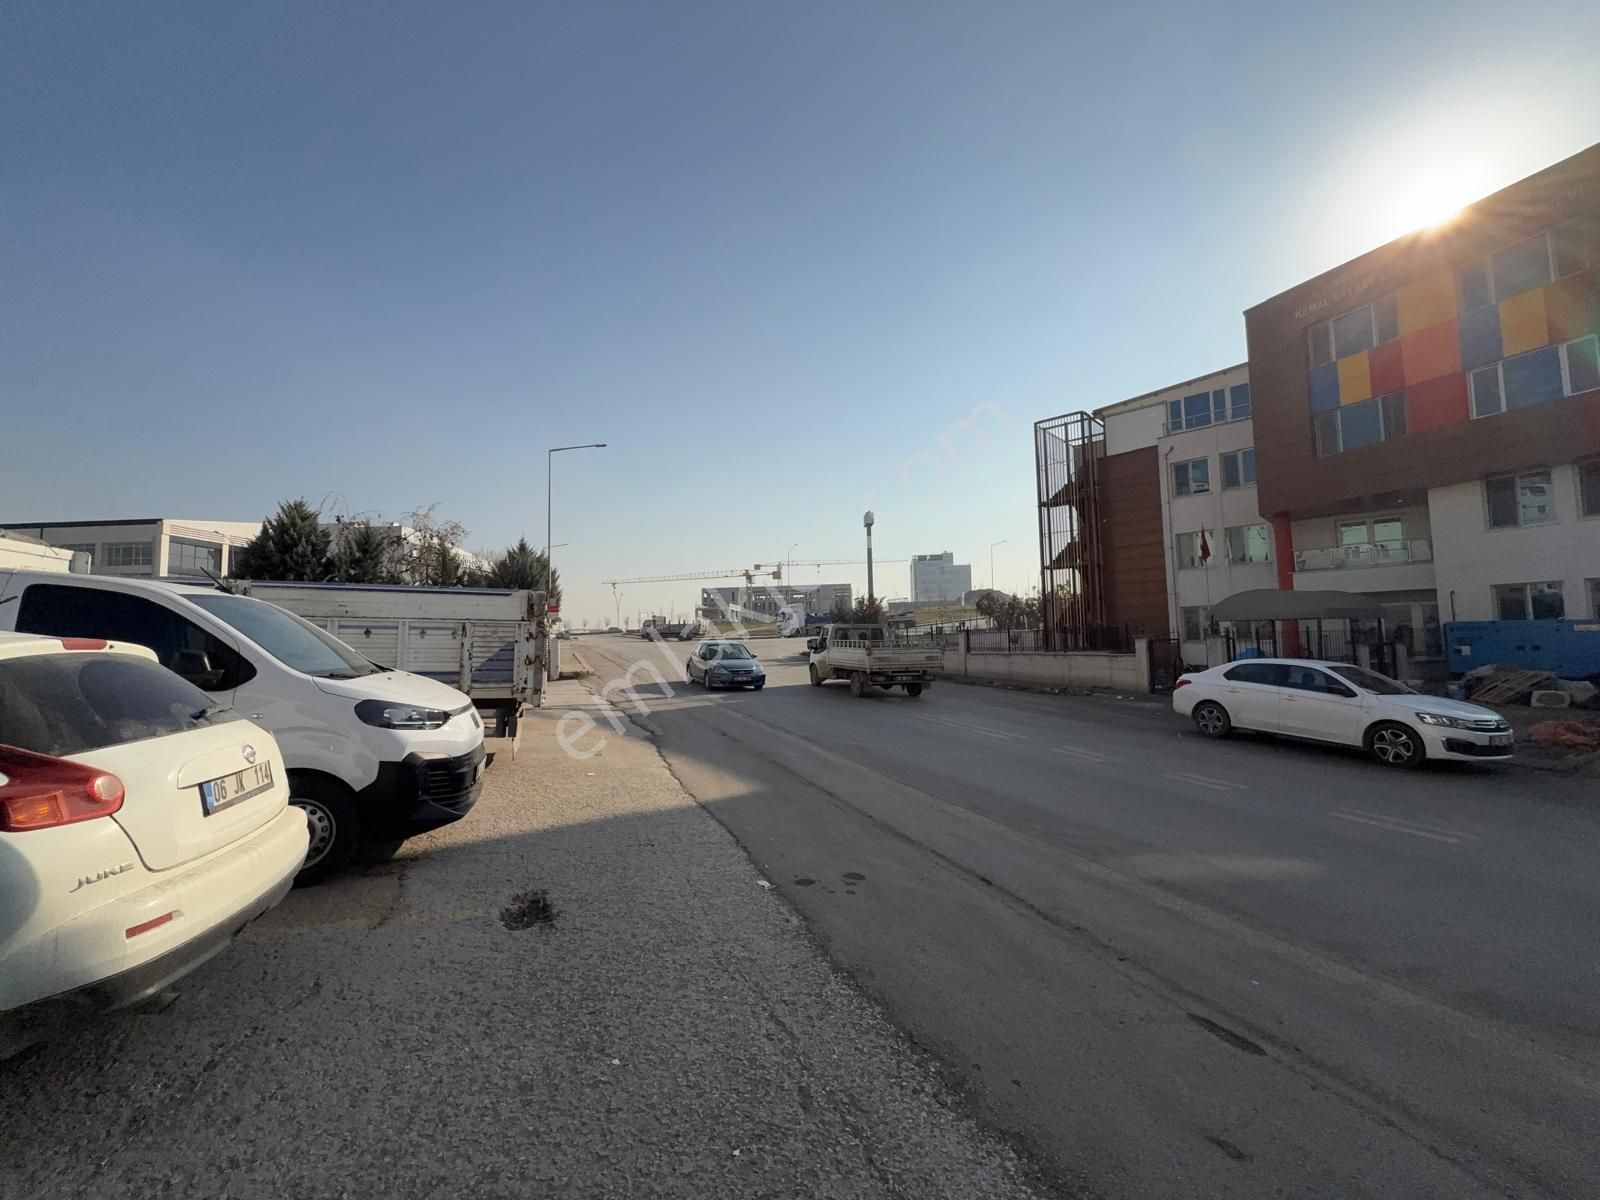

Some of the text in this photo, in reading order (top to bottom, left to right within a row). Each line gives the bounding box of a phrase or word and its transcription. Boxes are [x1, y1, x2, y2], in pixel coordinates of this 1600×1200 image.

[213, 779, 227, 803] 06
[234, 770, 246, 795] JK
[254, 761, 270, 785] 114
[69, 861, 135, 894] JUKE
